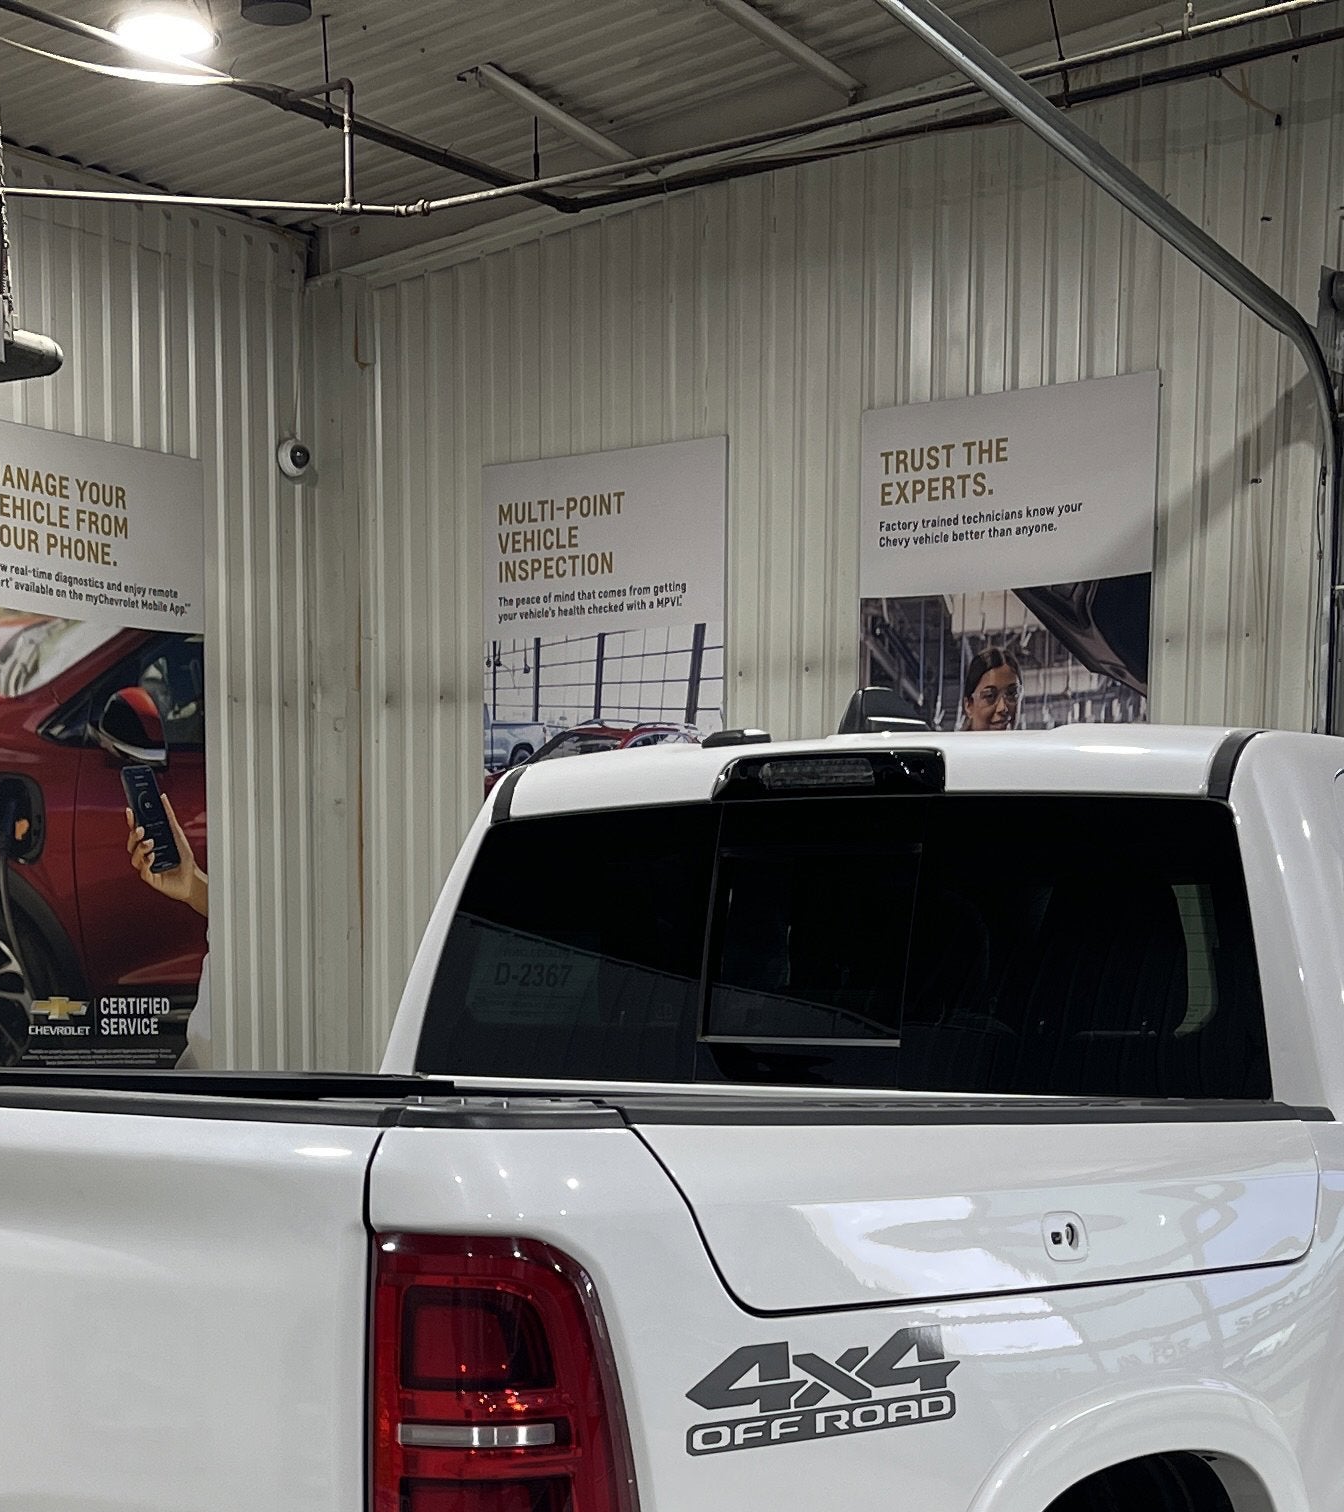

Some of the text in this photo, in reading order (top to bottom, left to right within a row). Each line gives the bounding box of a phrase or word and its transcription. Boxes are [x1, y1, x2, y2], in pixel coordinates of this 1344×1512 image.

[880, 437, 1009, 475] TRUST THE
[75, 478, 127, 510] YOUR
[880, 472, 994, 506] EXPERTS.
[498, 491, 625, 526] MULTI-POINT
[879, 502, 1083, 533] Factory trained technicians know your
[76, 509, 128, 540] FROM
[498, 526, 579, 554] VEHICLE
[879, 522, 1057, 549] Chevy vehicle better than anyone.
[46, 533, 118, 567] PHONE.
[10, 564, 53, 580] real-time
[54, 571, 104, 590] diagnostics
[106, 581, 121, 592] and
[123, 583, 146, 597] enjoy
[148, 587, 178, 599] remote
[498, 551, 614, 584] INSPECTION
[14, 580, 54, 596] available
[56, 589, 66, 598] on
[68, 589, 83, 601] the
[85, 593, 139, 610] myChevrolet
[141, 600, 167, 612] Mobile
[498, 581, 687, 609] The peace of mind that comes from getting
[497, 610, 517, 624] your
[519, 607, 556, 620] vehicle's
[558, 602, 586, 617] health
[587, 600, 624, 614] checked
[626, 598, 646, 611] with
[648, 599, 654, 609] a
[494, 963, 573, 987] D-2367
[100, 997, 170, 1015] CERTIFIED
[28, 1025, 91, 1036] CHEVROLET
[100, 1018, 159, 1035] SERVICE
[691, 1395, 951, 1451] OFF ROAD
